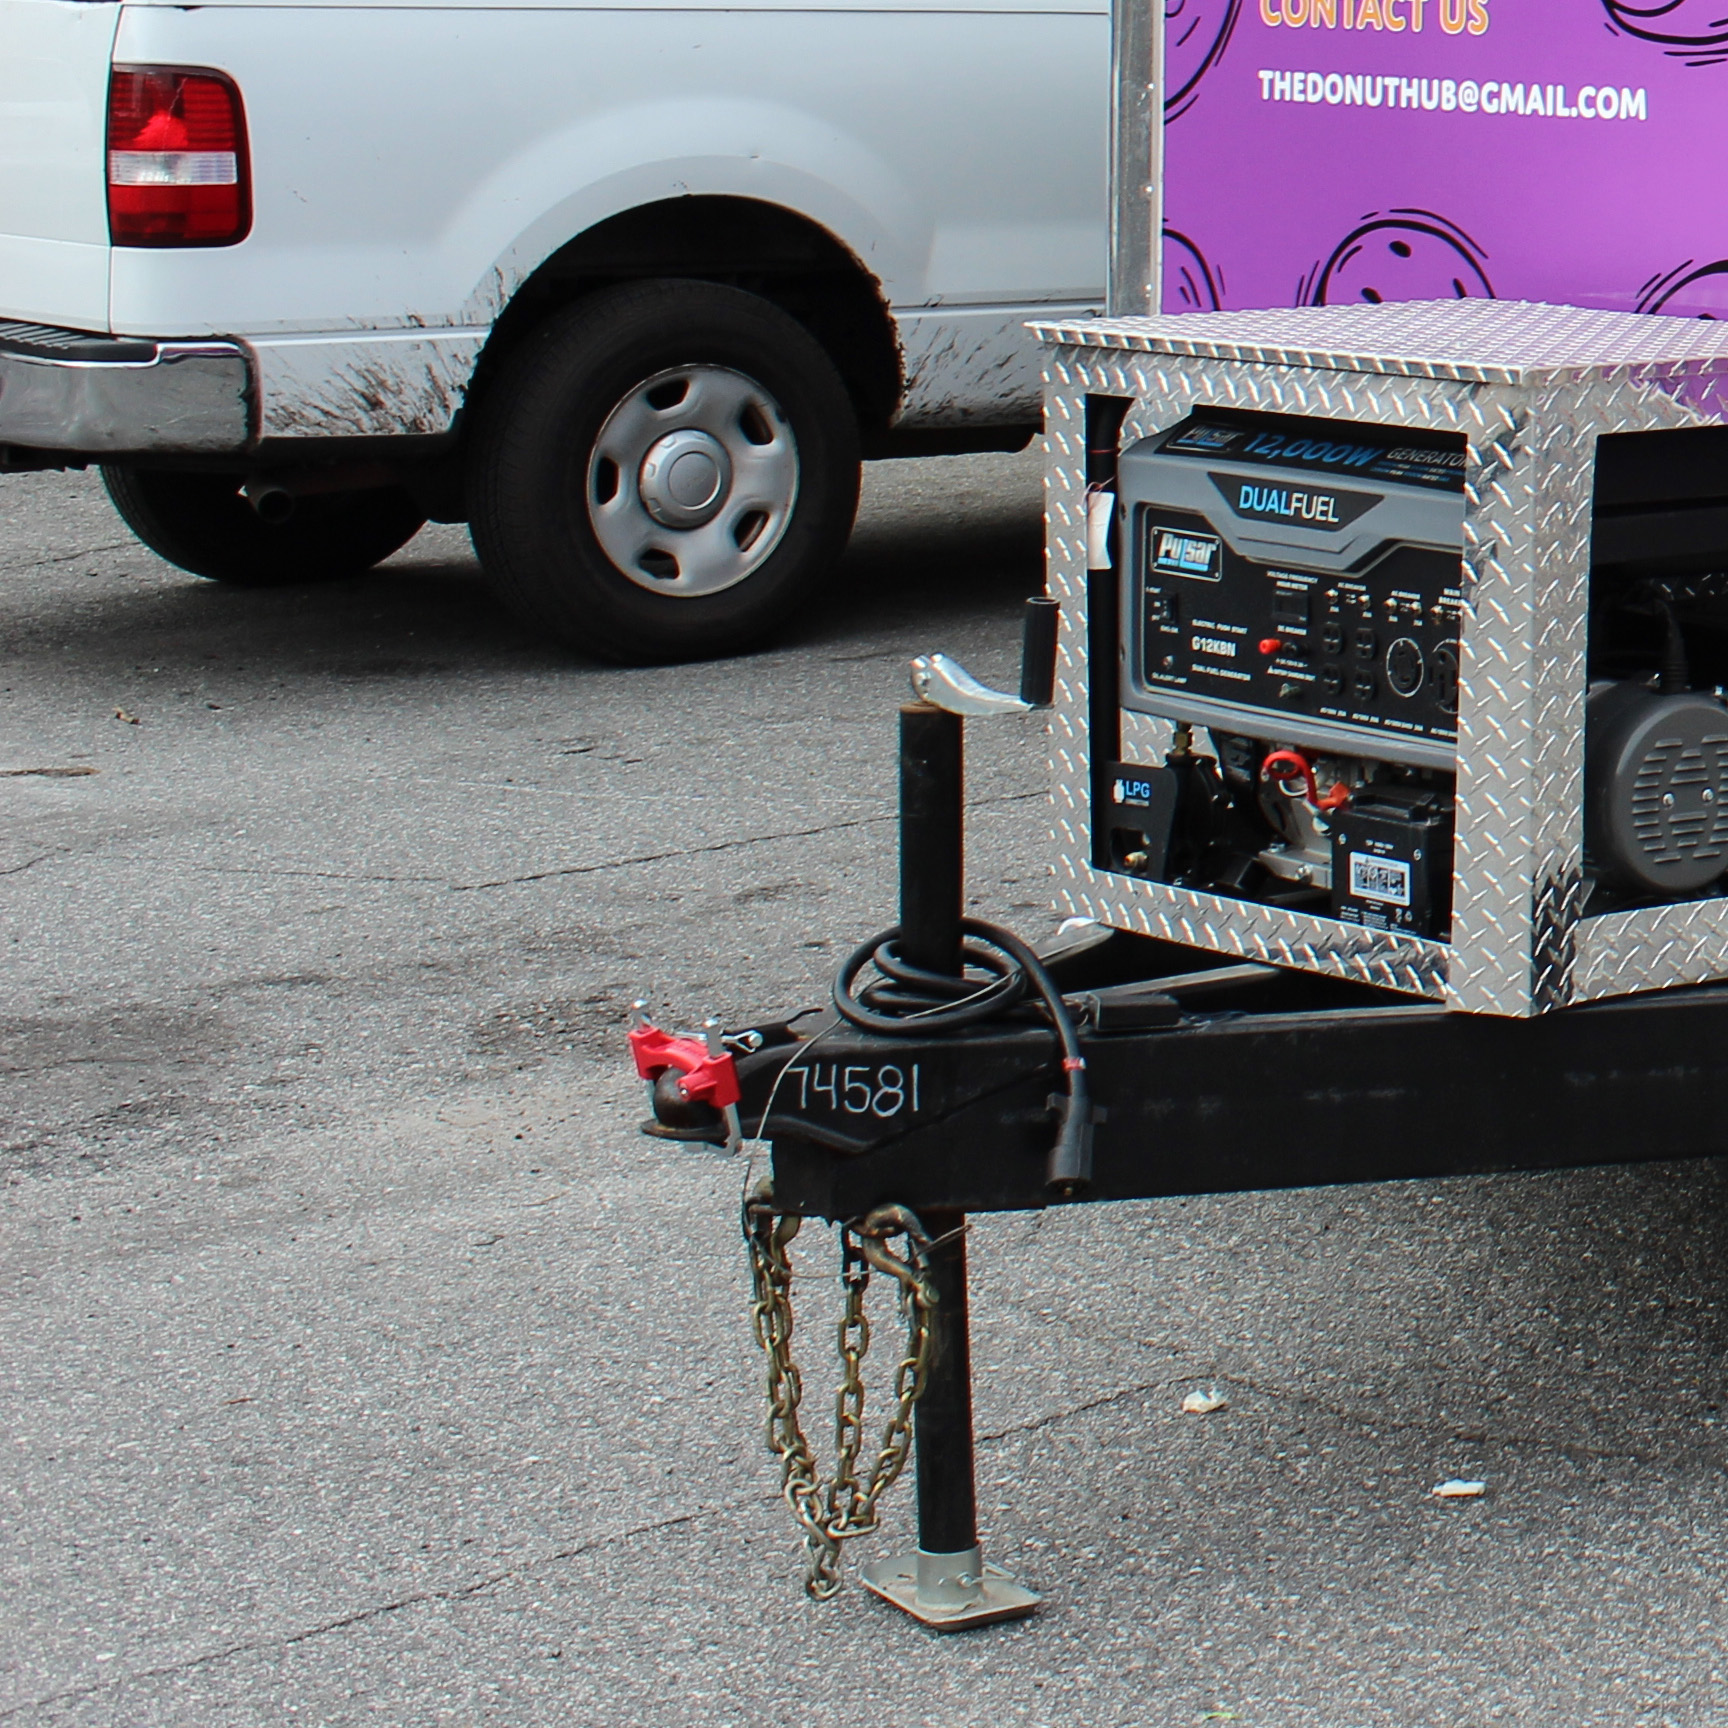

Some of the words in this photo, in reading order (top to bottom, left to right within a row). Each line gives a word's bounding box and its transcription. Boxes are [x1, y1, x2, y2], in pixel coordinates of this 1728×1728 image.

[1258, 70, 1647, 120] THEDONUTHUB@GMAIL.COM
[1244, 432, 1384, 467] 12,000W
[1159, 533, 1217, 570] Pulsar
[1125, 780, 1151, 798] LPG
[786, 1063, 920, 1118] 74581
